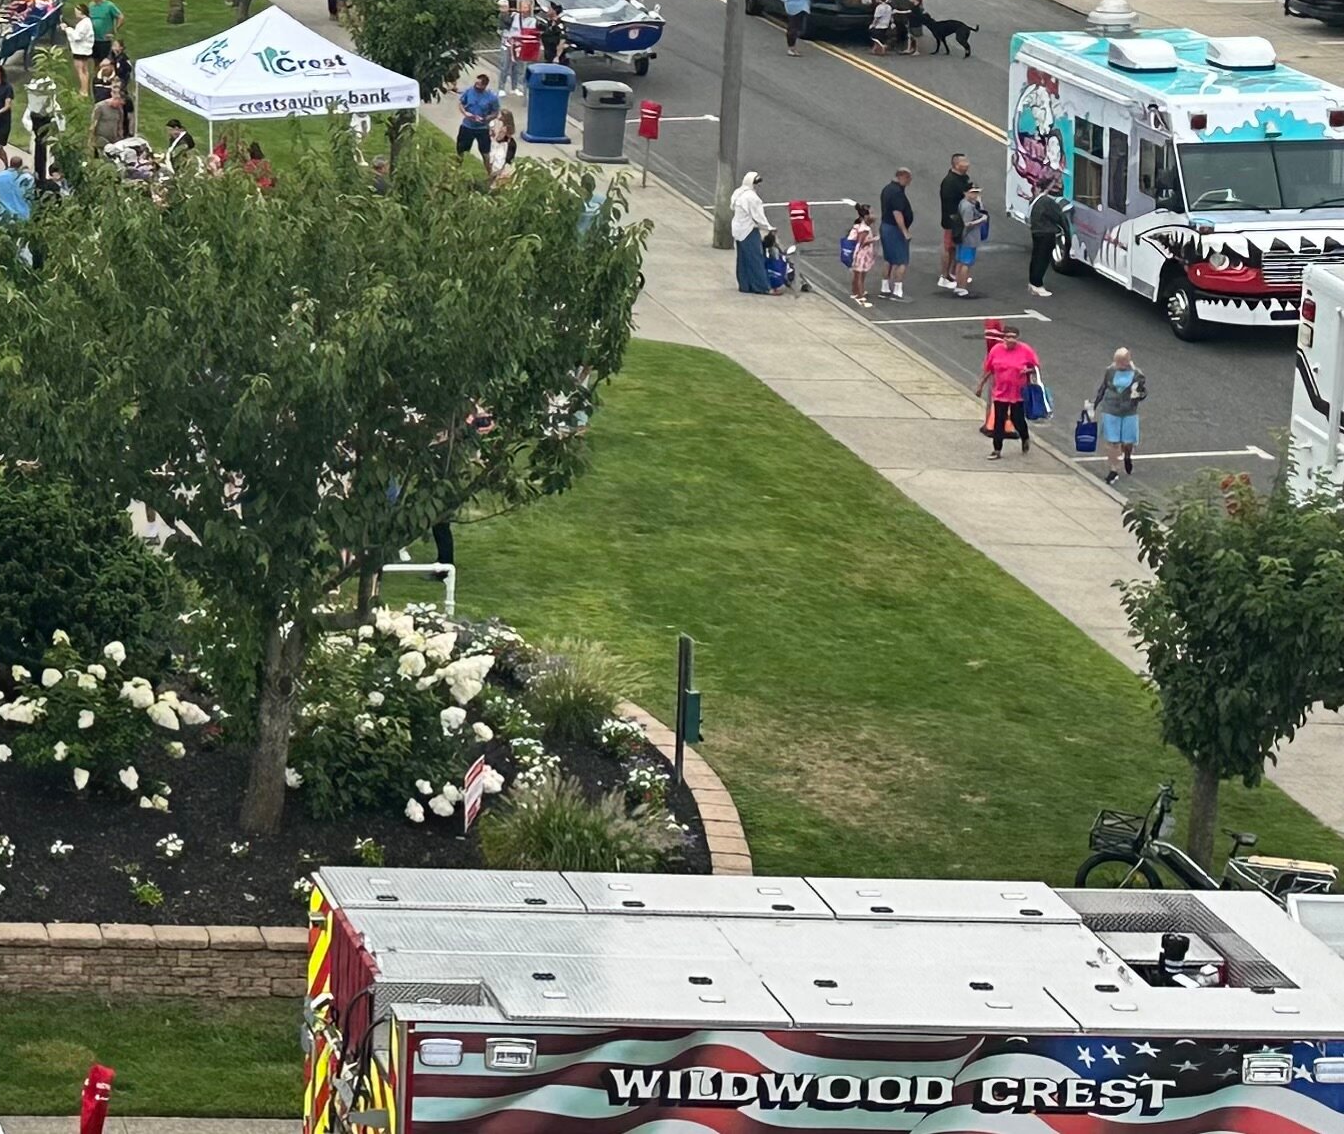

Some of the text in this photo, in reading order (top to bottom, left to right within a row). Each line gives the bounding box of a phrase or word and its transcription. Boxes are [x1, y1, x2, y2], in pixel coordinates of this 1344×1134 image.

[276, 53, 347, 72] Crest
[609, 1067, 1178, 1112] WILDWOOD CREST
